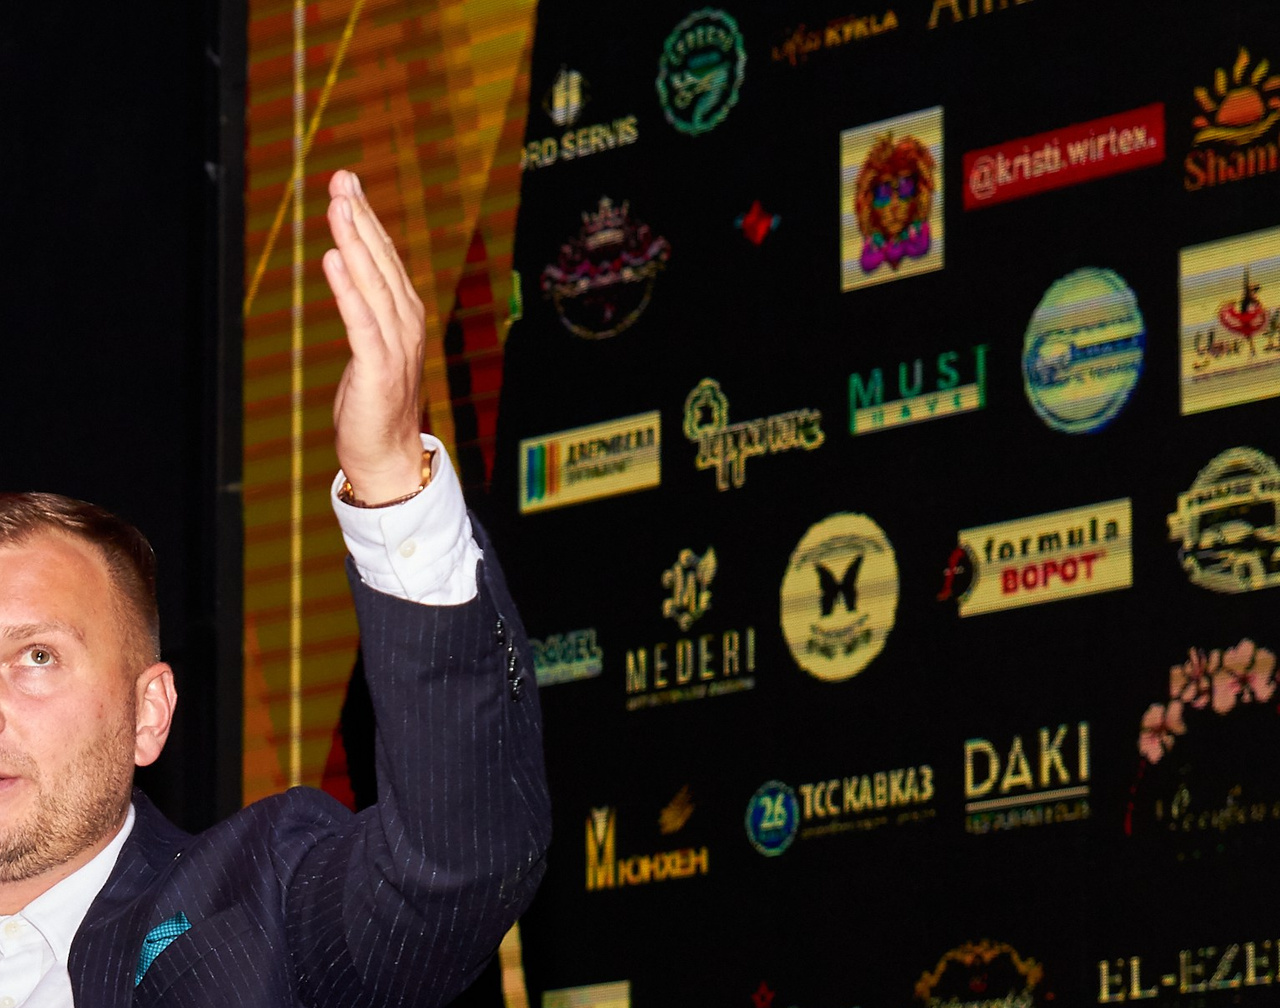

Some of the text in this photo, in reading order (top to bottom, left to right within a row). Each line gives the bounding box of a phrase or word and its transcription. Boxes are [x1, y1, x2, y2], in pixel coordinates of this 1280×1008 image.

[561, 115, 638, 161] SERVIS
[1184, 142, 1280, 192] Sham
[849, 344, 989, 436] MUST
[983, 518, 1118, 563] formula
[626, 627, 755, 694] MEDERI
[963, 720, 1090, 799] DAKI
[799, 765, 936, 820] ТСС КАВКАЗ
[1097, 938, 1280, 1004] EL-EZE
